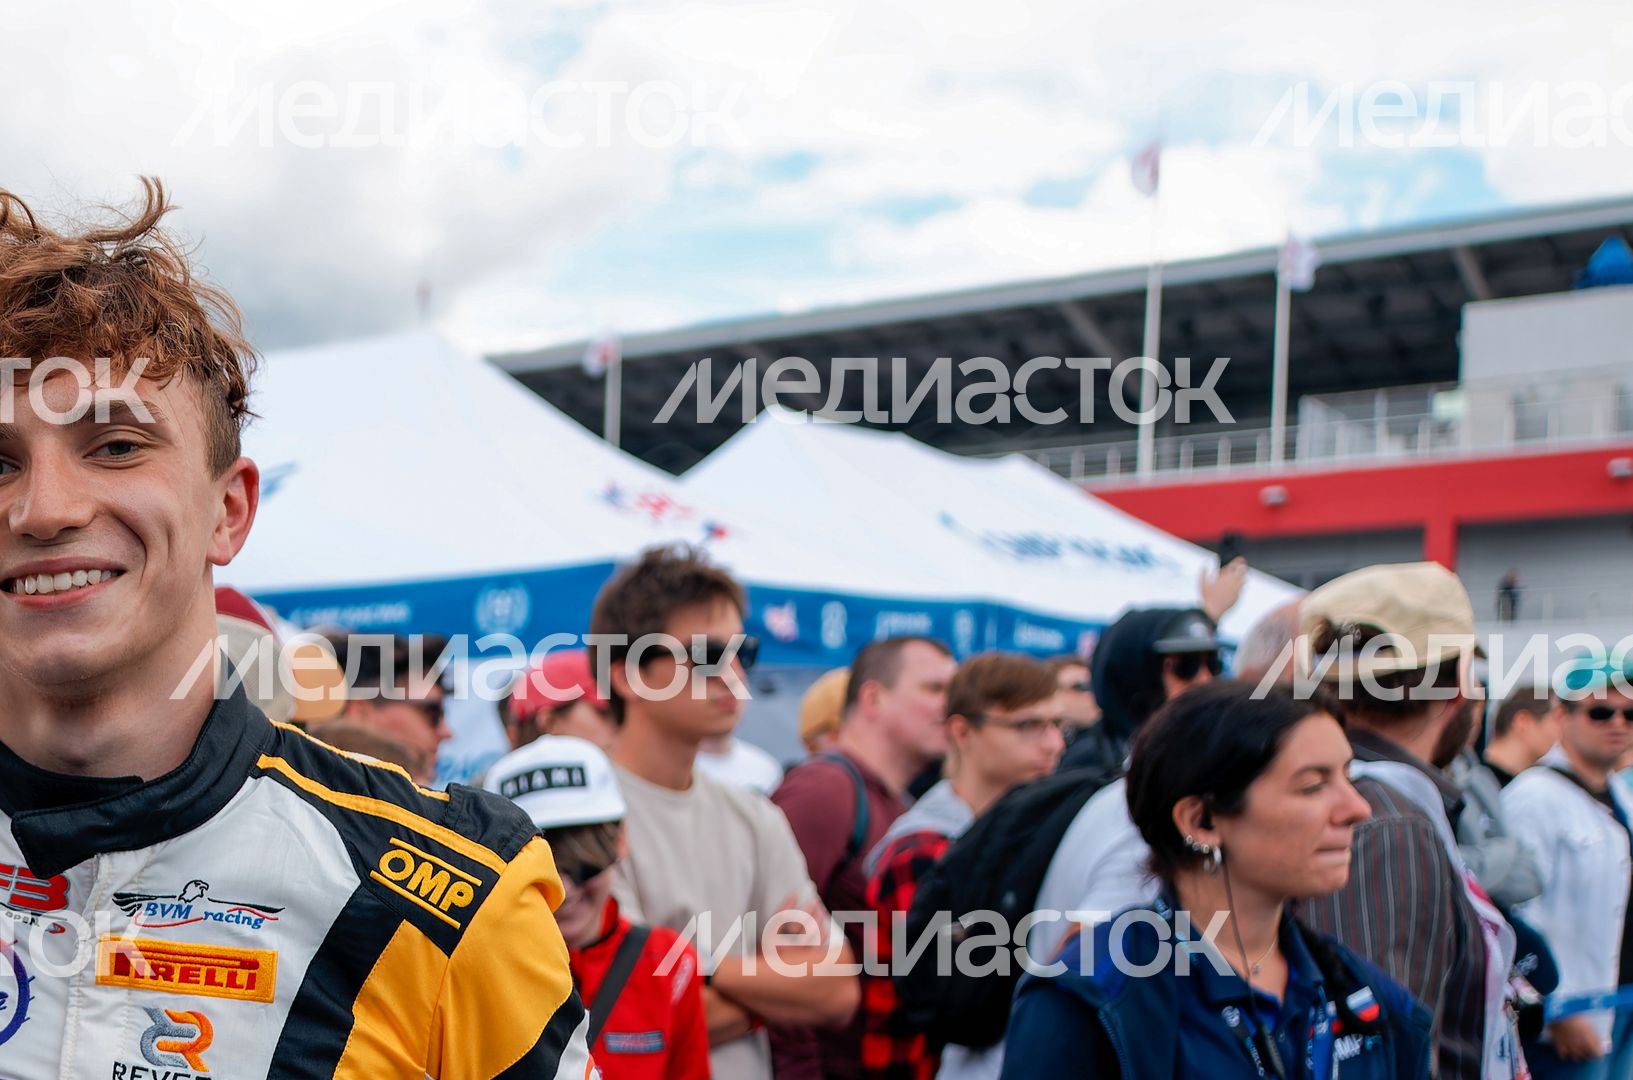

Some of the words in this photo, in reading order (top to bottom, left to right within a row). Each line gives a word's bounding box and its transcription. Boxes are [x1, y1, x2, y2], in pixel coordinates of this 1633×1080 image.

[378, 848, 475, 912] OMP
[145, 901, 194, 920] BVM
[203, 910, 265, 930] racing
[113, 944, 261, 991] PIRELLI
